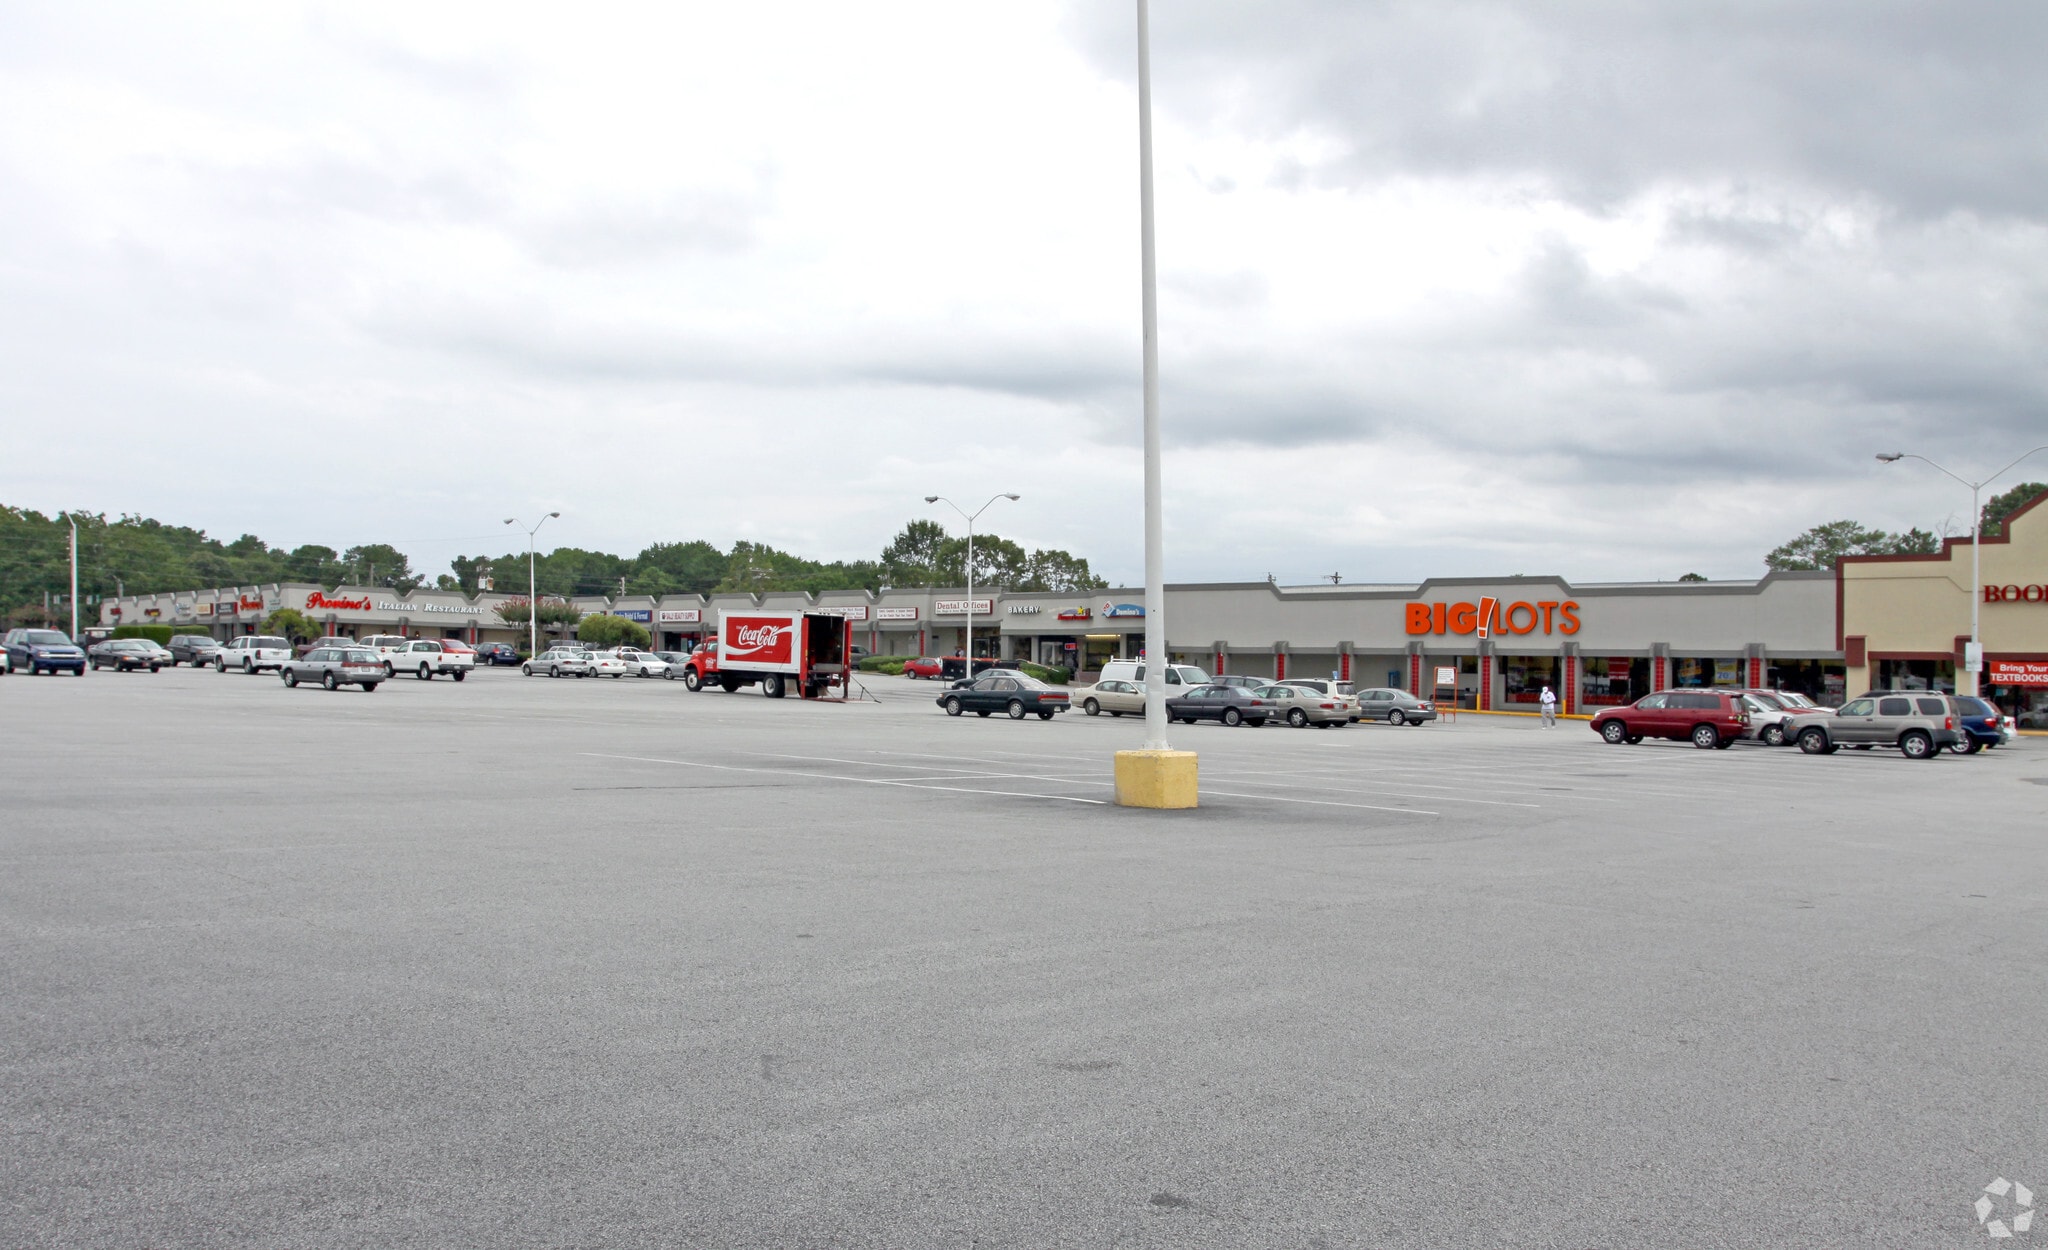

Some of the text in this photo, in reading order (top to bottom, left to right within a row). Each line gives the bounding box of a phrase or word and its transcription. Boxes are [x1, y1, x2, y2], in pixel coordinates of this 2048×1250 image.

[1983, 584, 2048, 604] BOO
[306, 591, 485, 615] Provino's ITALIAN RESTAURANT
[937, 602, 960, 610] Dental
[1008, 606, 1040, 614] BAKERY
[2000, 664, 2024, 673] Bring
[1991, 674, 2048, 682] TEXTBOOKS
